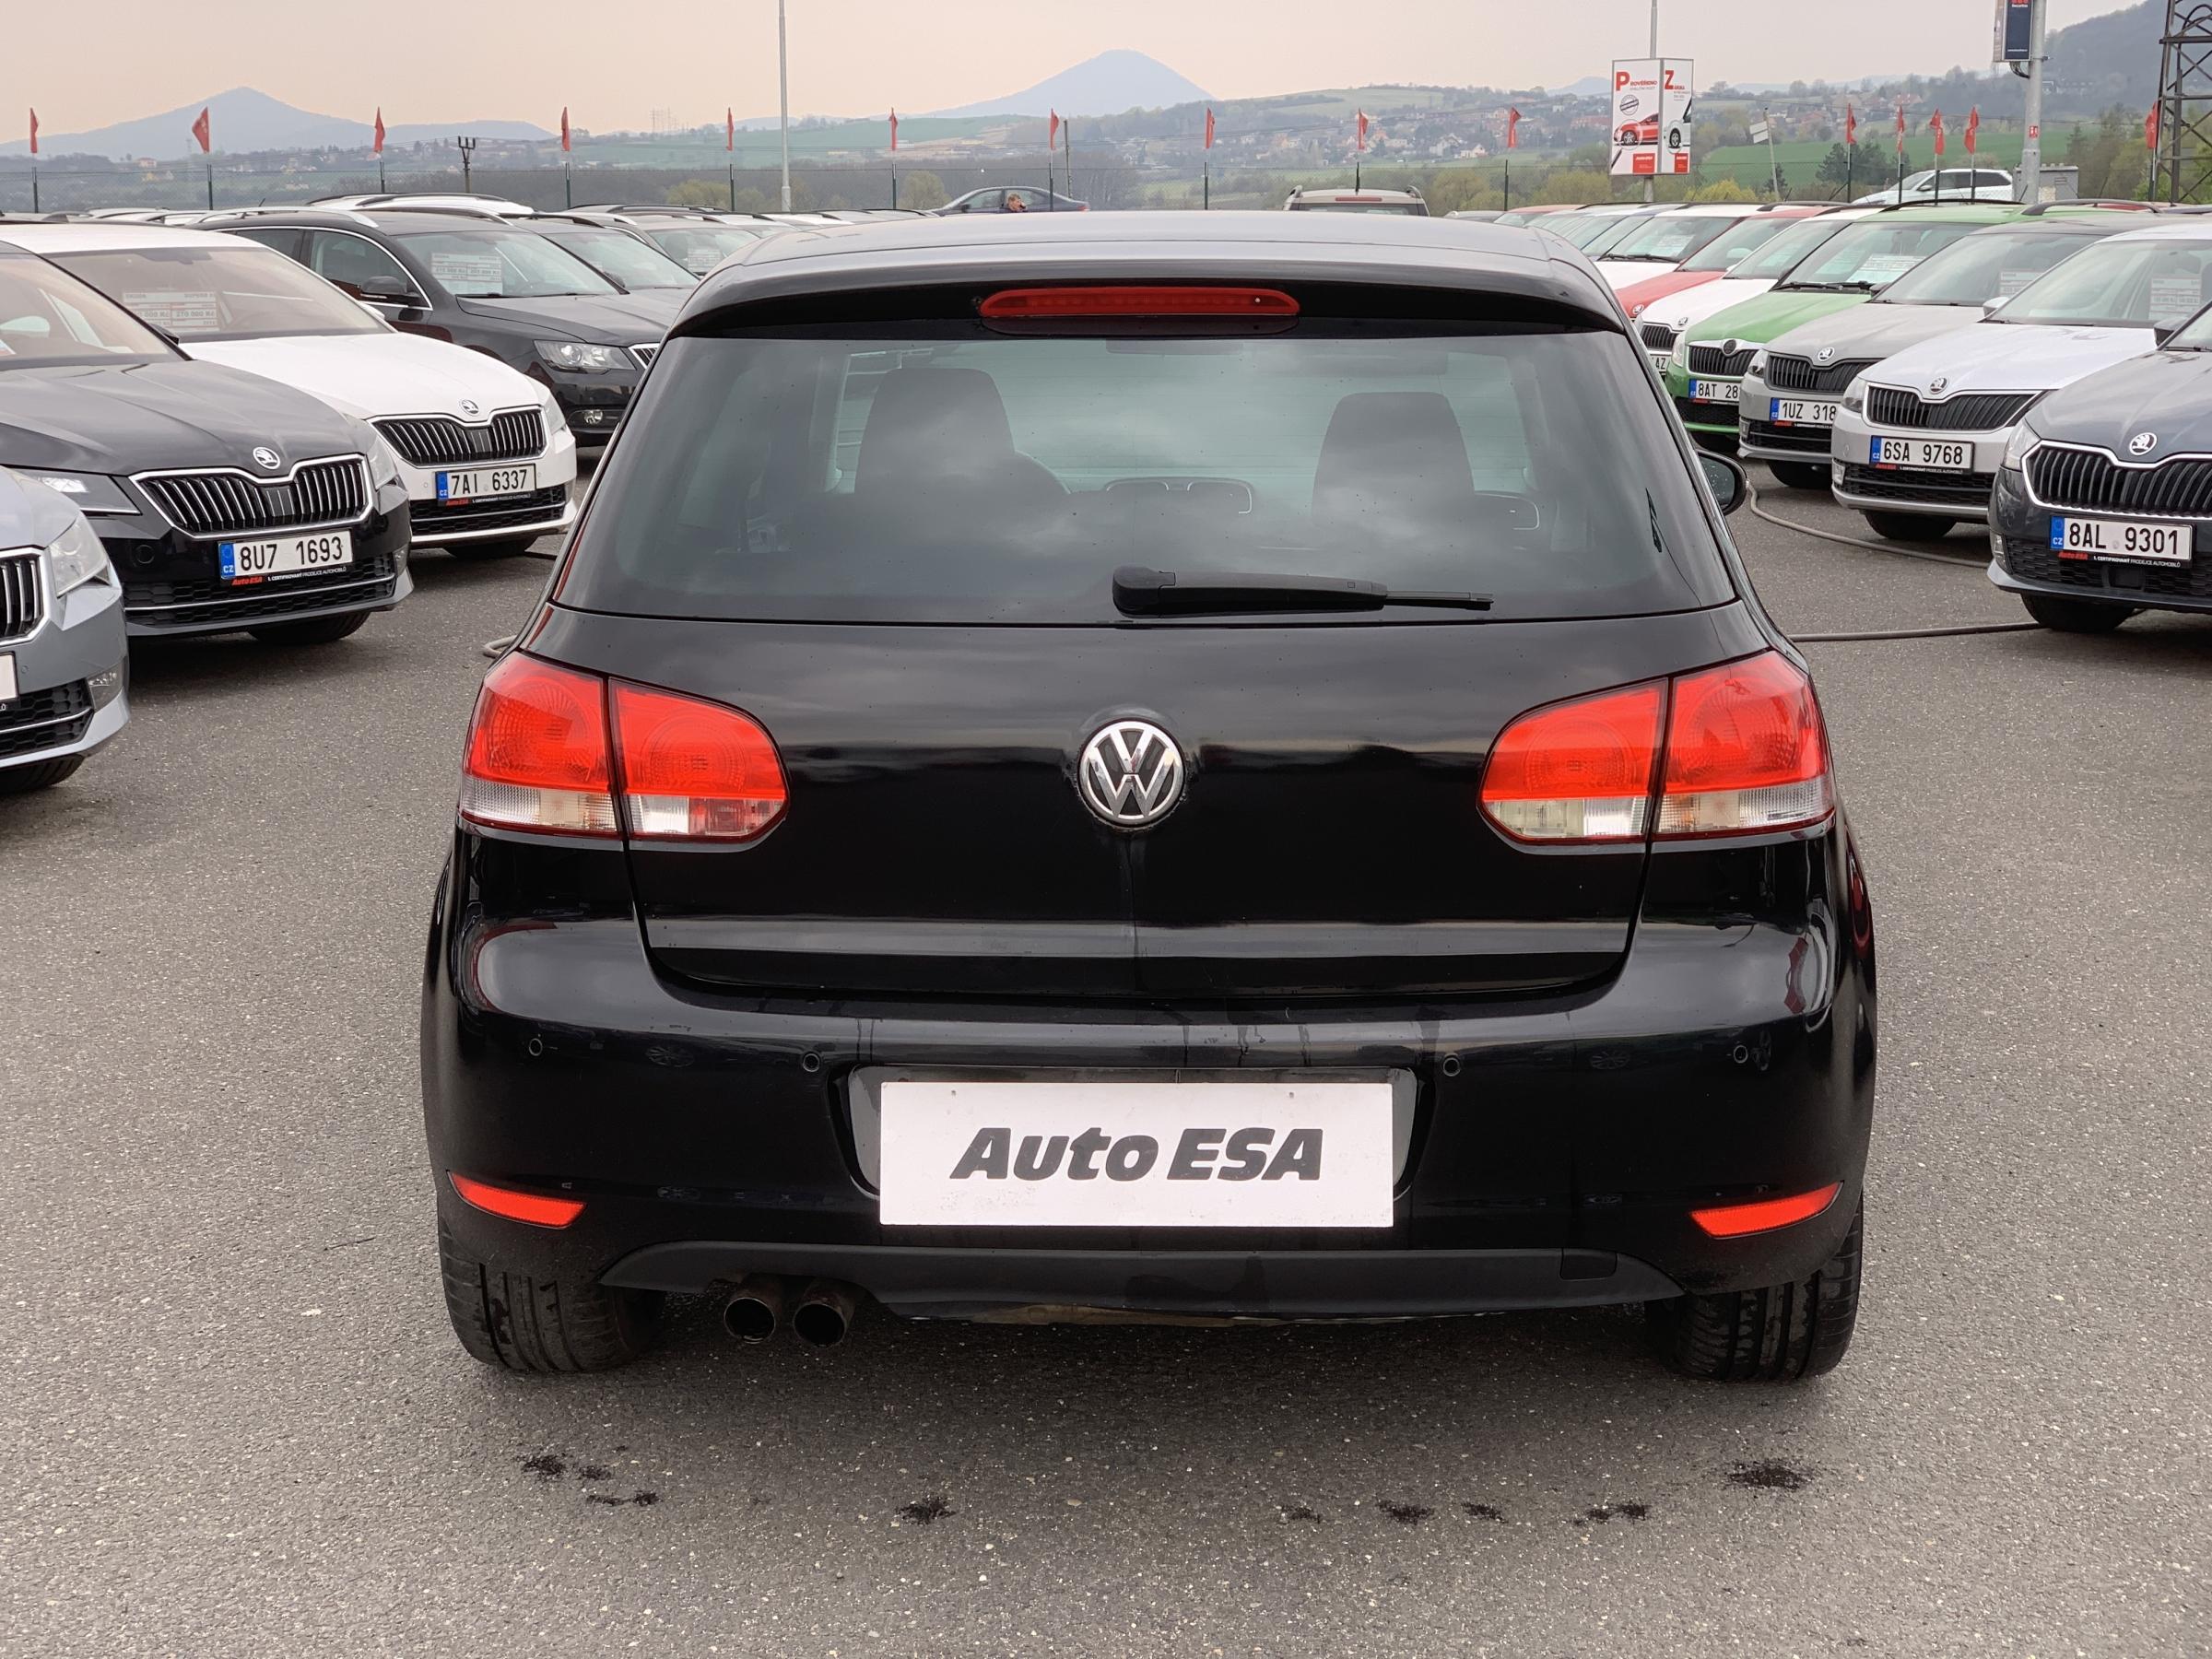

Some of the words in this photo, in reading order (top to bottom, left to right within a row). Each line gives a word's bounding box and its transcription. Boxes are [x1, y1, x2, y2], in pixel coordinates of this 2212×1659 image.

[1653, 356, 1666, 371] AZ
[1698, 382, 1717, 397] 8AT
[1782, 402, 1804, 419] 1UZ
[1884, 441, 1910, 462] 6SA
[1923, 443, 1963, 465] 9768
[452, 474, 477, 495] 7AI
[492, 469, 527, 491] 6337
[2053, 537, 2064, 546] CZ
[2068, 522, 2107, 550] 8AL
[2124, 526, 2178, 556] 9301
[240, 543, 277, 571] 8U7
[296, 535, 343, 565] 1693
[222, 564, 234, 574] CZ
[949, 1126, 1159, 1182] Auto
[1166, 1127, 1324, 1182] ESA
